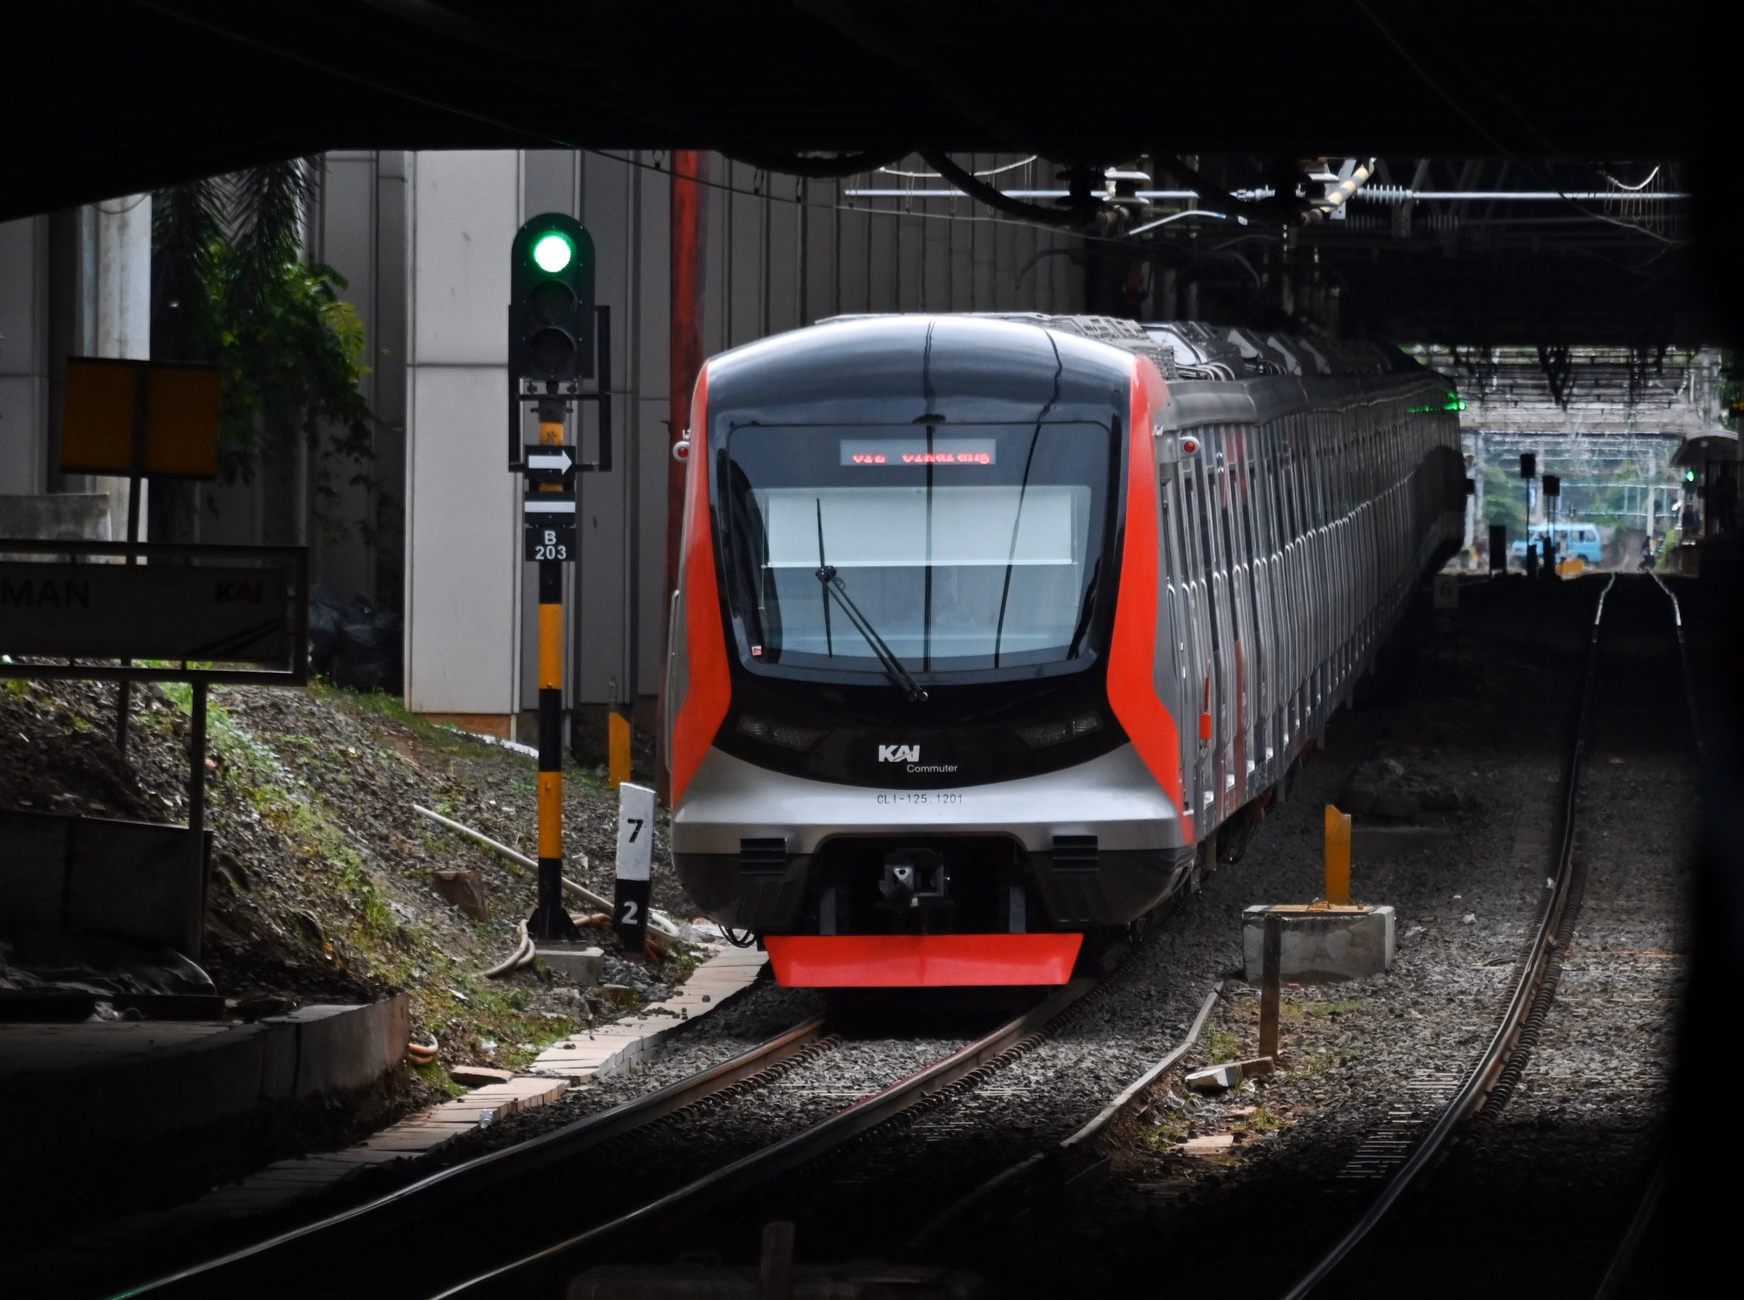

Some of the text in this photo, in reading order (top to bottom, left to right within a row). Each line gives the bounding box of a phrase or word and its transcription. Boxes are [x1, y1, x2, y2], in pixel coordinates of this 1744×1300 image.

[544, 530, 557, 545] B
[535, 545, 567, 560] 203
[1, 578, 90, 608] MAN
[878, 744, 920, 762] KAI
[906, 764, 958, 773] Commuter
[627, 818, 643, 843] 7
[621, 901, 638, 925] 2
